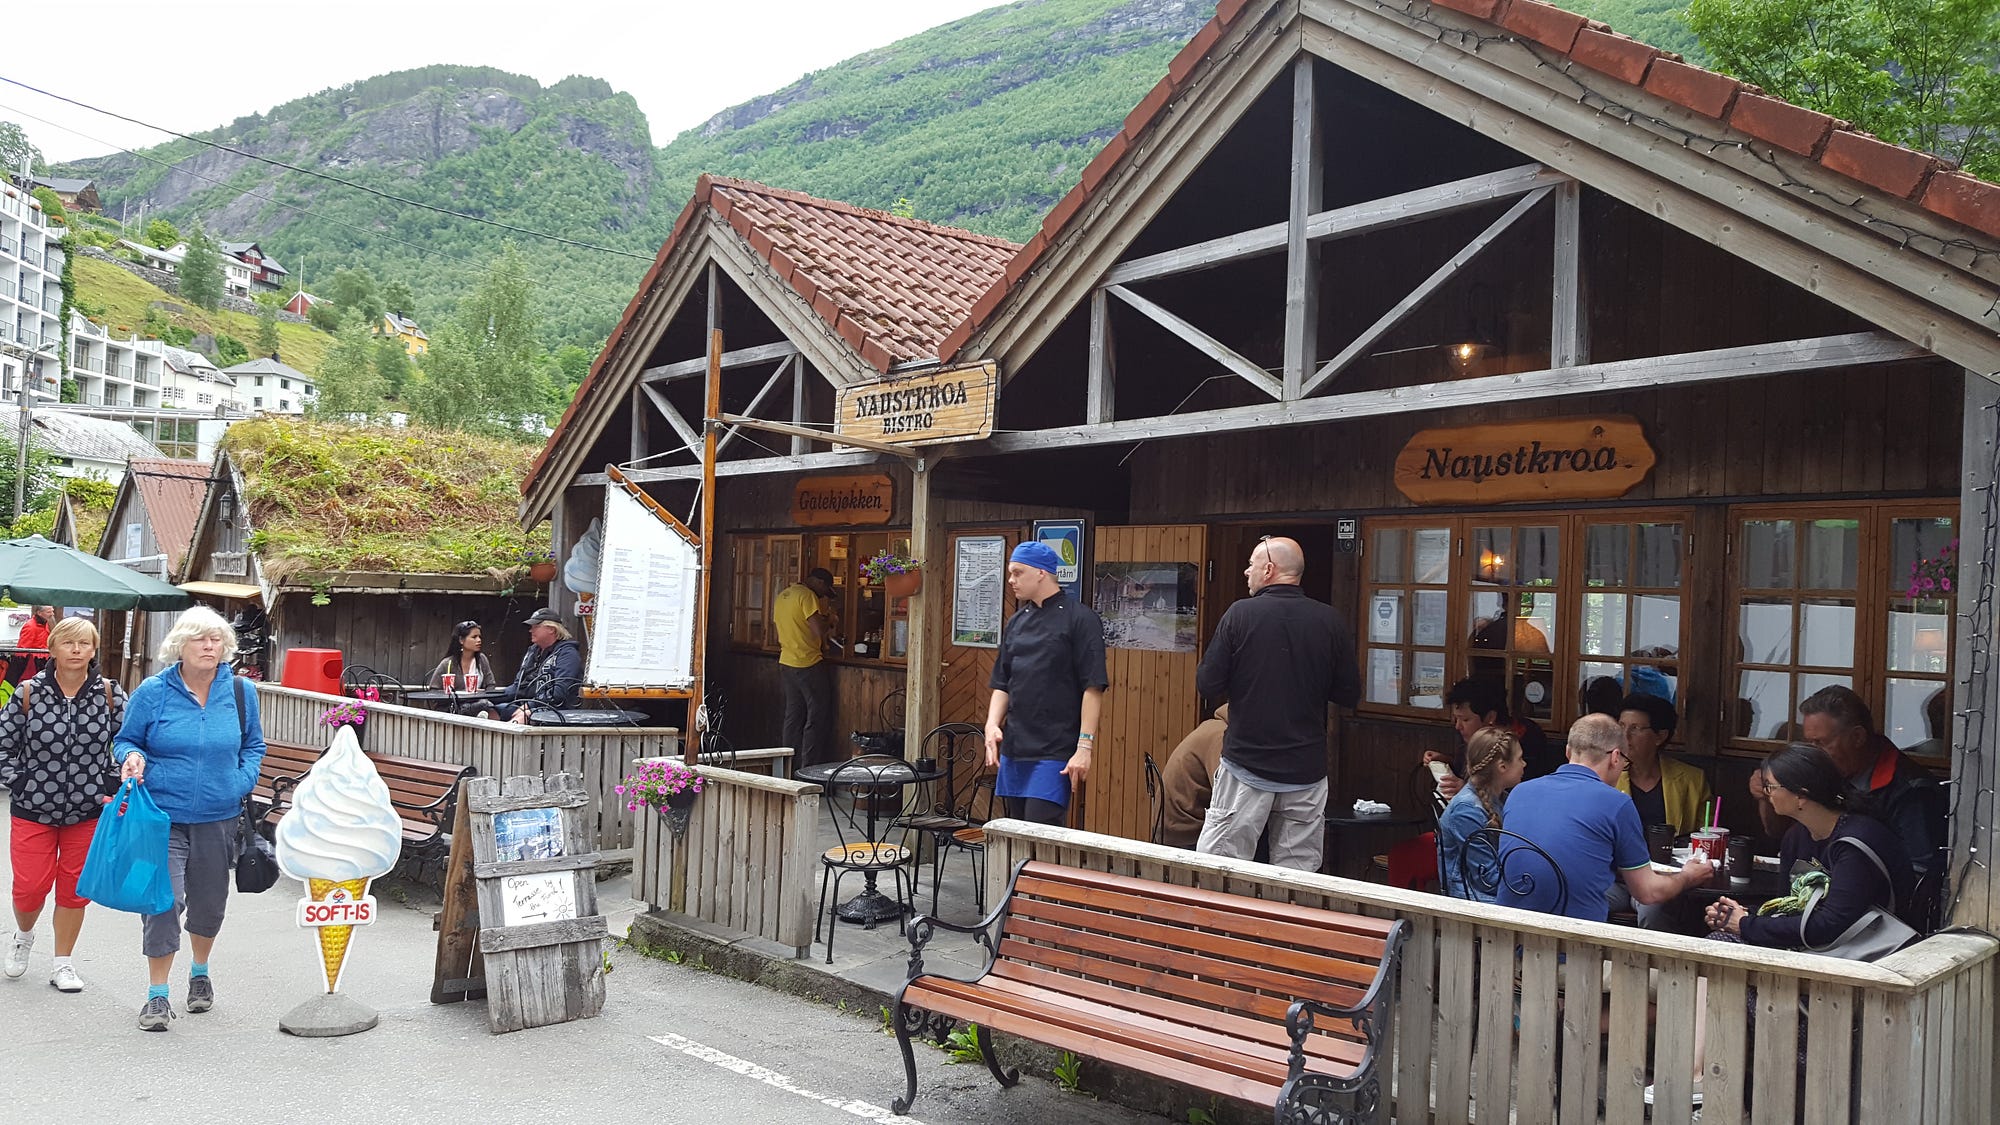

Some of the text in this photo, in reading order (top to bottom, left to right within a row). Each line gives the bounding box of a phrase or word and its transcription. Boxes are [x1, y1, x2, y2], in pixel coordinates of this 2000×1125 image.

[856, 380, 968, 418] NAUSTKROA
[883, 412, 933, 435] BISTRO
[1421, 441, 1618, 479] Naustkroa
[800, 489, 882, 513] Gatekjøkken
[1057, 568, 1074, 578] rtårn
[578, 604, 595, 614] SOF
[507, 877, 529, 890] Open
[305, 902, 370, 922] SOFT-IS
